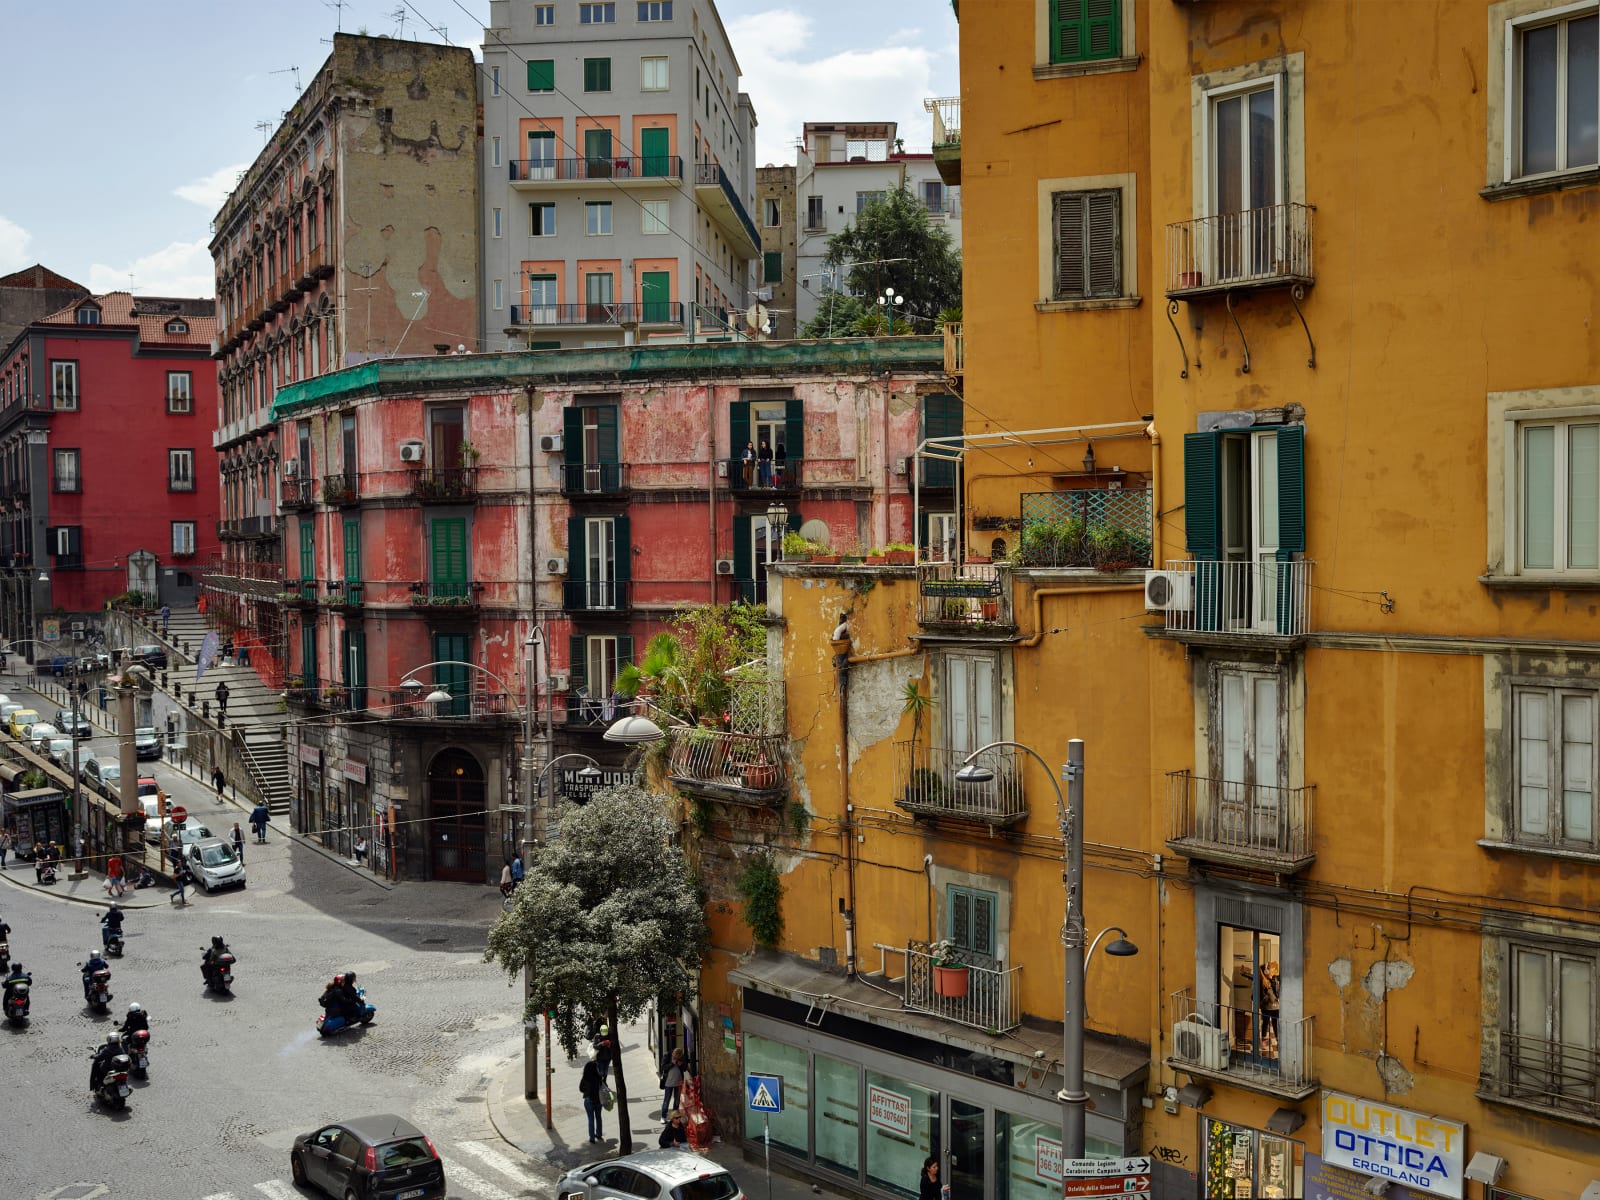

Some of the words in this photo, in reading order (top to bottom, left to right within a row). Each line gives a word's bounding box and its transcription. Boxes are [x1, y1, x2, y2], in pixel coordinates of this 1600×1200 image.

[872, 1094, 907, 1113] AFFITTASI
[872, 1106, 882, 1118] 366
[1327, 1097, 1458, 1153] OUTLET
[1335, 1129, 1448, 1178] OTTICA
[1040, 1158, 1052, 1171] 366
[1097, 1160, 1116, 1168] Legione
[1097, 1167, 1121, 1175] Campania
[1352, 1158, 1430, 1188] ERCOLANO
